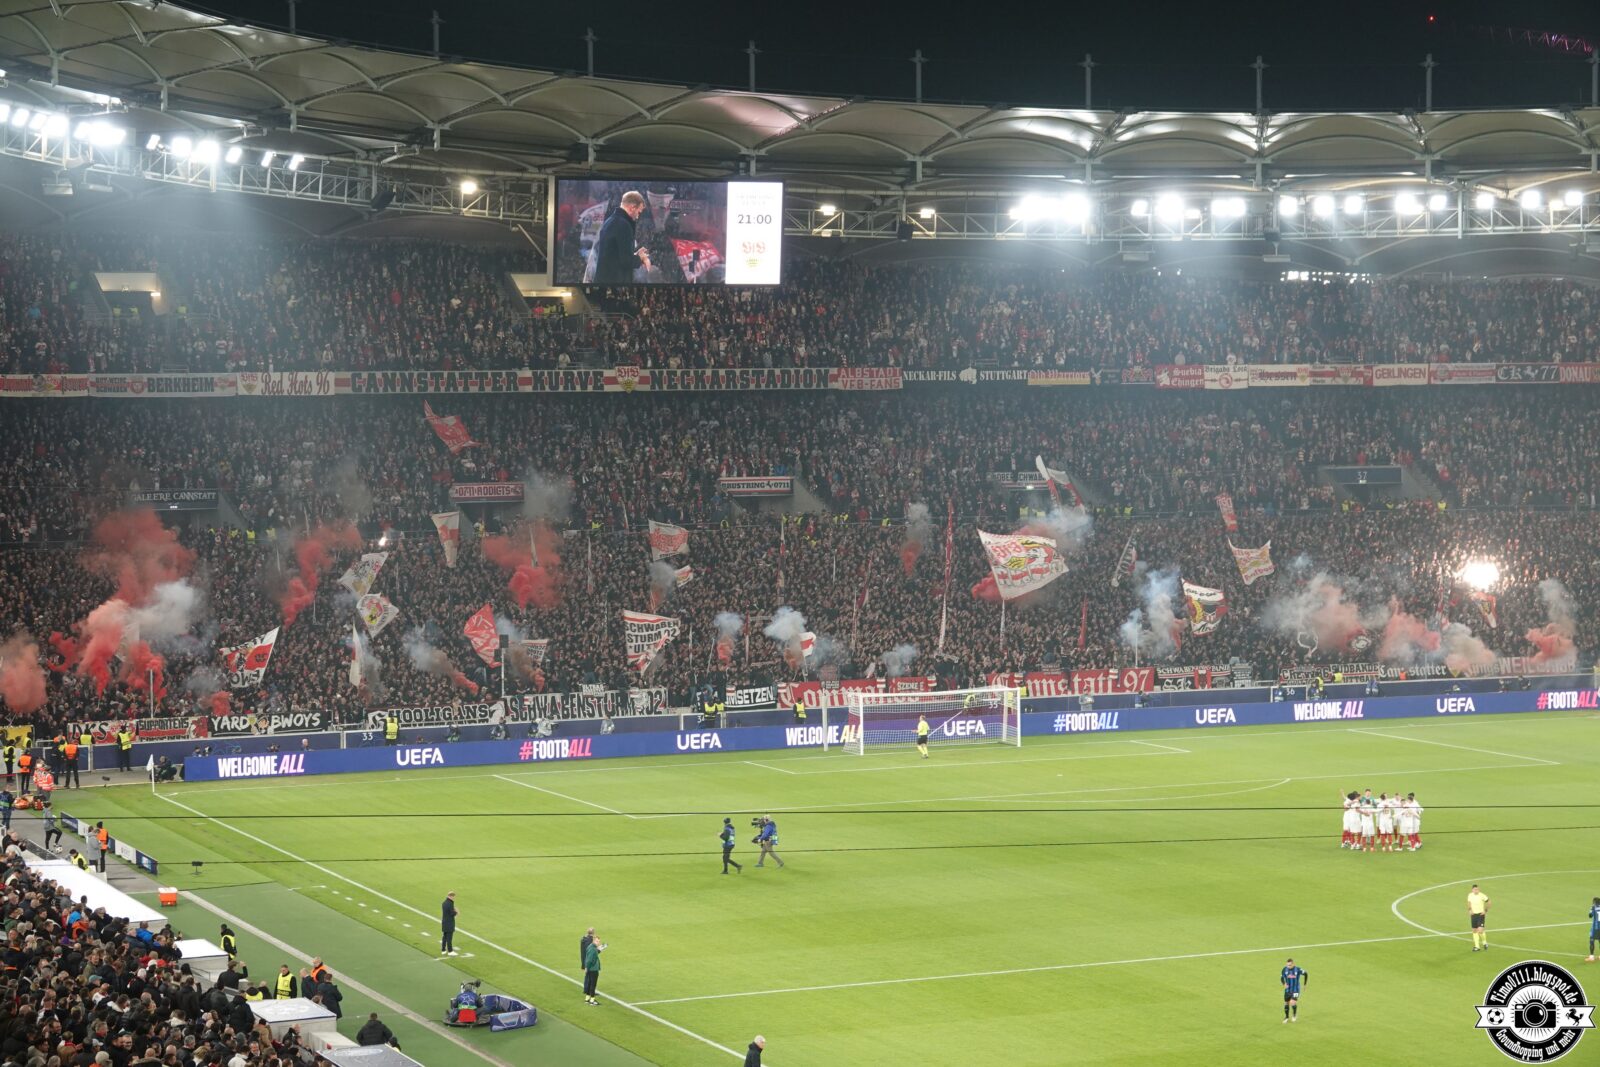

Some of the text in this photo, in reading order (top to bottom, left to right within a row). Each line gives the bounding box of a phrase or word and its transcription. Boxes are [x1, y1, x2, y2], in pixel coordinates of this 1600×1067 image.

[738, 214, 772, 225] 21:00
[351, 368, 829, 393] CANNSTATTER KURVE NECKARSTADION
[840, 368, 900, 378] ALBSTADT
[903, 370, 1027, 381] NECKAR-FILS STUTTGART
[1375, 368, 1427, 379] GERLINGEN
[147, 377, 215, 393] BERKHEIM
[261, 371, 330, 395] Red Hots 96
[842, 378, 900, 389] VFB-FANS
[173, 491, 216, 500] CANNSTATT
[627, 631, 662, 643] STURM
[1123, 670, 1149, 694] 97
[1436, 696, 1475, 713] UEFA
[1537, 691, 1598, 709] #FOOTBALL
[1195, 707, 1236, 725] UEFA
[1294, 700, 1364, 721] WELCOME ALL
[211, 712, 321, 731] YARD BWOYS
[943, 719, 987, 737] UEFA
[1054, 711, 1119, 732] #FOOTBALL
[676, 733, 722, 751] UEFA
[786, 724, 840, 746] WELCOME
[396, 747, 444, 766] UEFA
[519, 737, 592, 760] #FOOTBALL
[217, 753, 305, 778] WELCOME ALL
